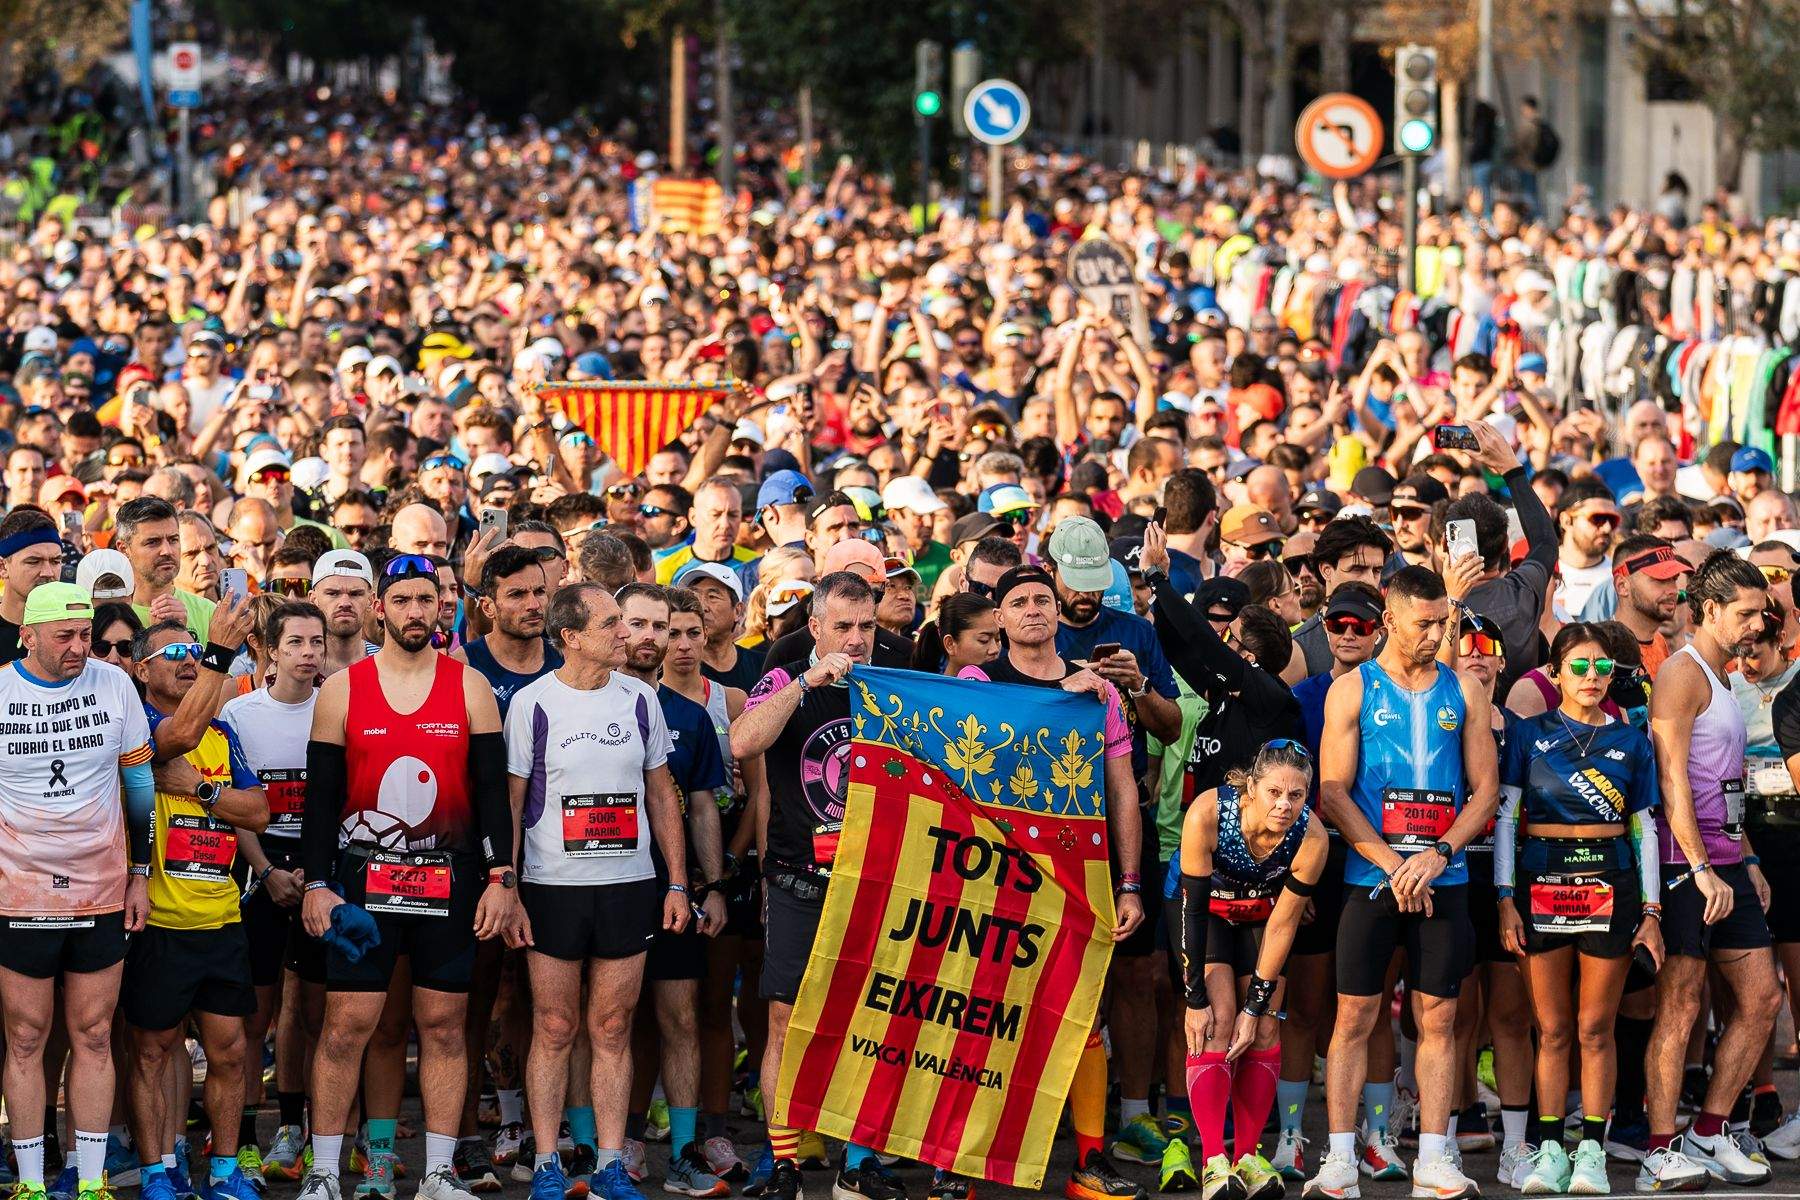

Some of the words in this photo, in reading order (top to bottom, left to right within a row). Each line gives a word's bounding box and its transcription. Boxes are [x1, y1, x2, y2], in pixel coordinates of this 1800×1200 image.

[8, 702, 29, 716] QUE
[31, 703, 44, 717] EL
[82, 693, 97, 708] NO
[0, 722, 33, 735] BORRE
[36, 721, 49, 734] LO
[52, 718, 73, 733] QUE
[75, 714, 90, 730] UN
[92, 709, 111, 727] DÍA
[363, 727, 387, 736] mobel
[8, 738, 49, 755] CUBRIÓ
[52, 739, 66, 752] EL
[68, 733, 104, 751] BARRO
[560, 732, 598, 750] ROLLITO
[588, 811, 617, 824] 5005
[1404, 807, 1440, 821] 20140
[584, 826, 622, 838] MARINO
[1406, 822, 1437, 833] Guerra
[189, 834, 222, 849] 29482
[927, 825, 1043, 893] TOTS
[1564, 854, 1604, 863] HANKER
[389, 869, 427, 883] 26273
[391, 884, 425, 896] MATEU
[1552, 889, 1590, 901] 26467
[1552, 903, 1591, 913] MIRIAM
[888, 898, 1046, 969] JUNTS
[864, 971, 1023, 1042] EIXIREM
[851, 1034, 907, 1067] VIXCA
[914, 1050, 1003, 1090] VALÈNCIA
